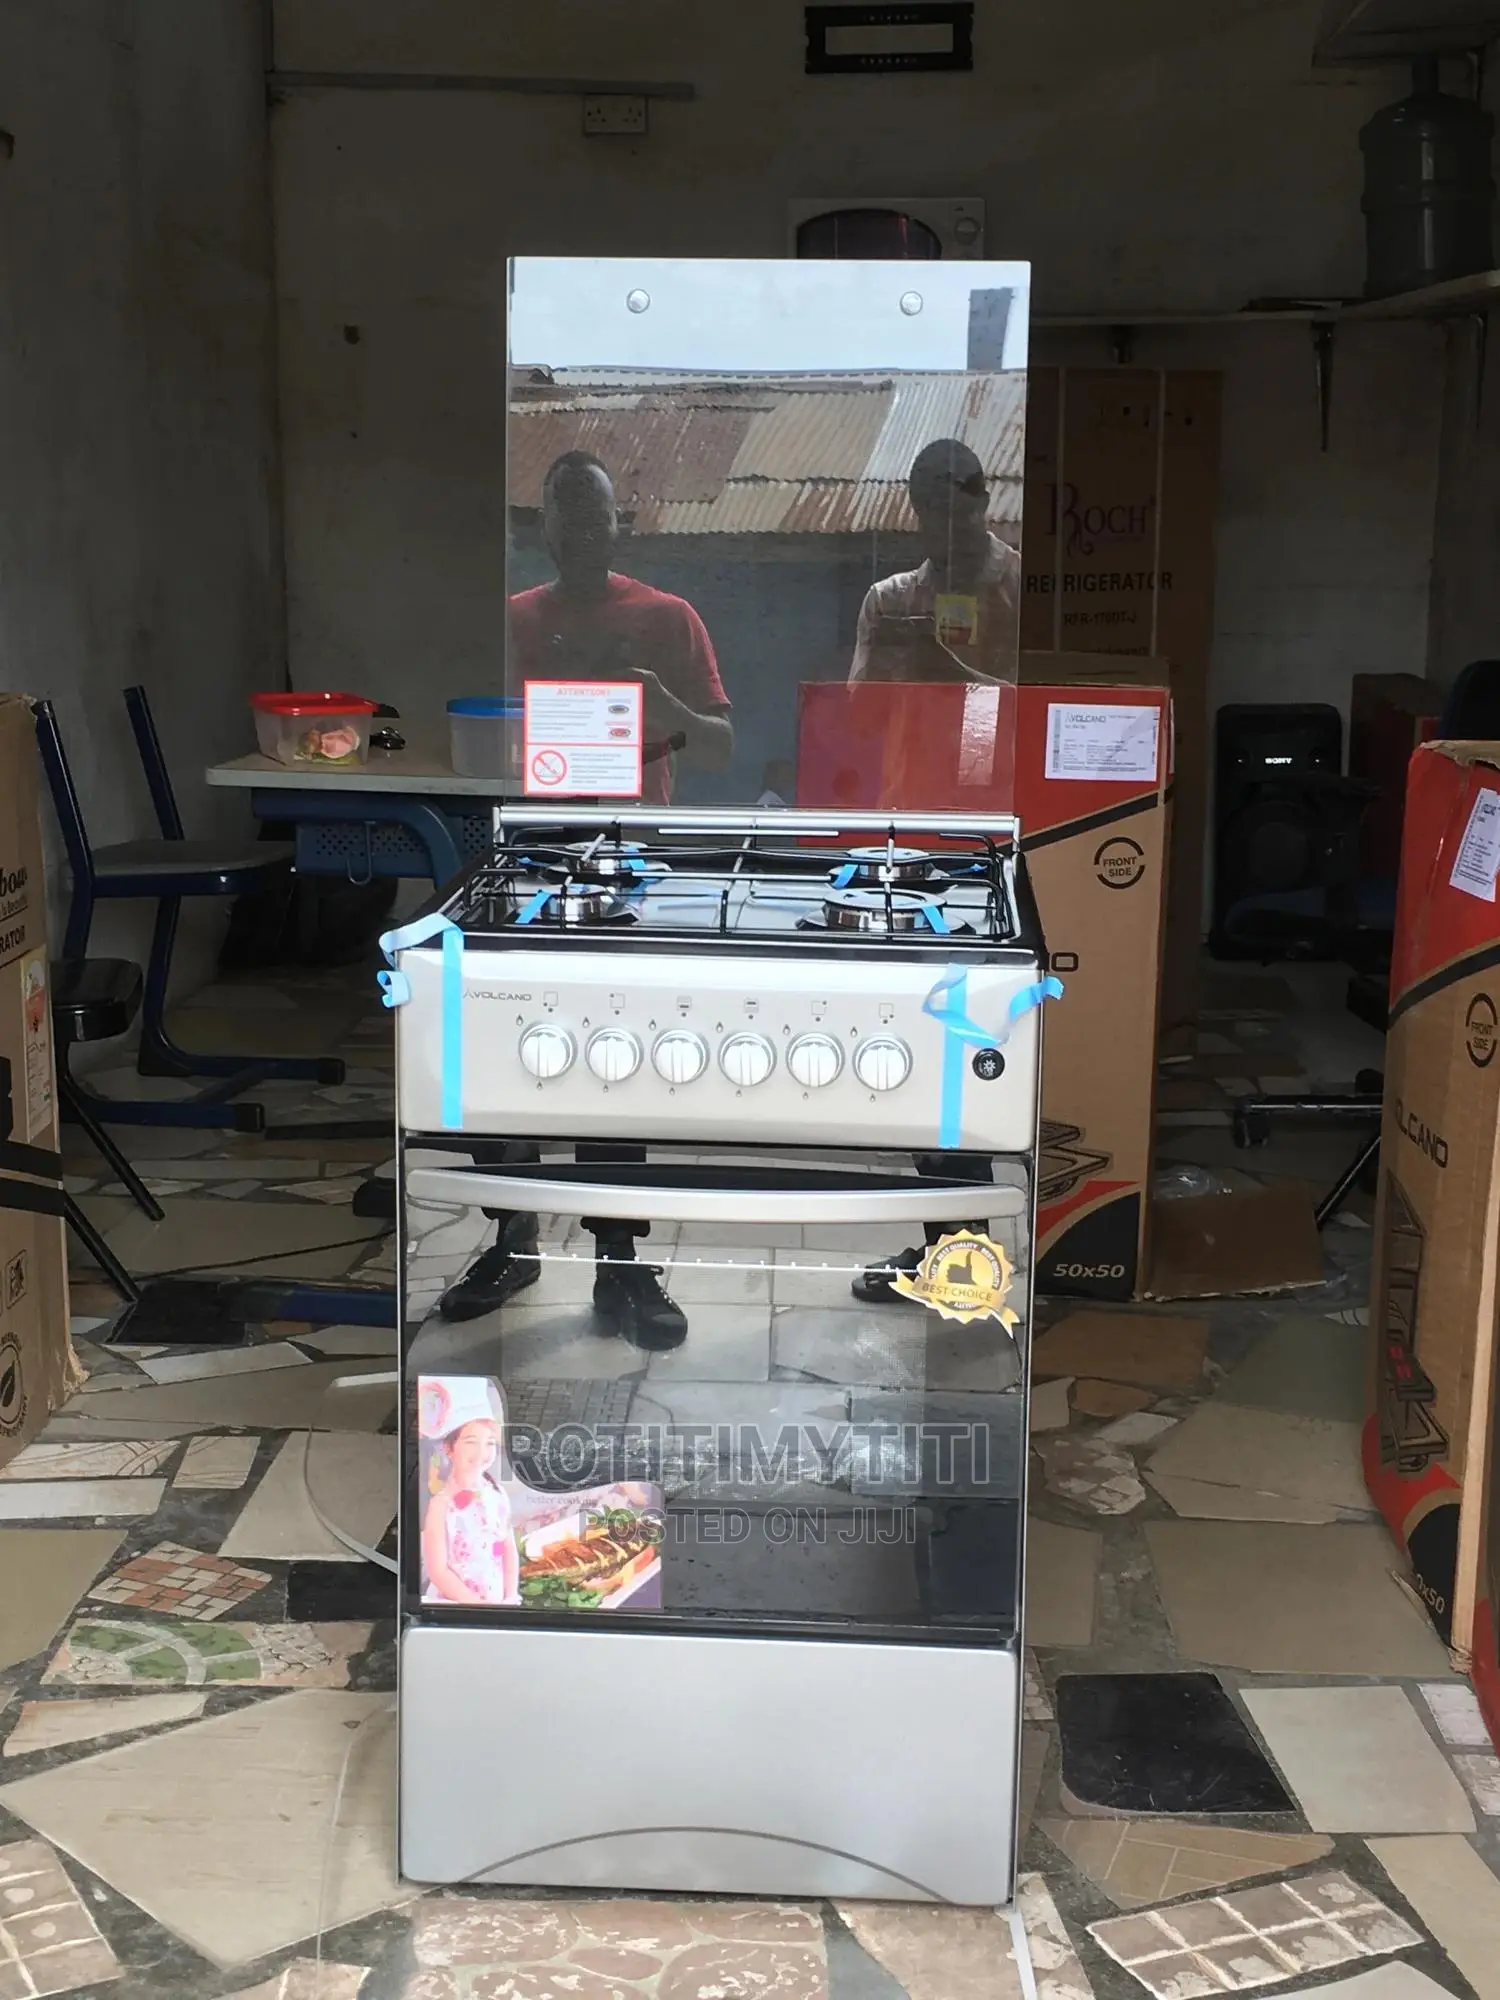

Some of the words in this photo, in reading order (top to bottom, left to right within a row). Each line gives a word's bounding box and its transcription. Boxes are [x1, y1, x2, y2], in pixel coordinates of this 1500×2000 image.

[1026, 571, 1173, 593] RERIGERATOR
[1264, 757, 1293, 765] SONY
[1103, 856, 1137, 867] FRONT
[1108, 867, 1132, 877] SIDE
[473, 990, 532, 1002] VOLCANO
[1395, 1097, 1449, 1168] OLCANO
[1053, 1263, 1125, 1278] 50x50
[922, 1283, 948, 1295] BEST
[951, 1288, 993, 1302] CHOICE
